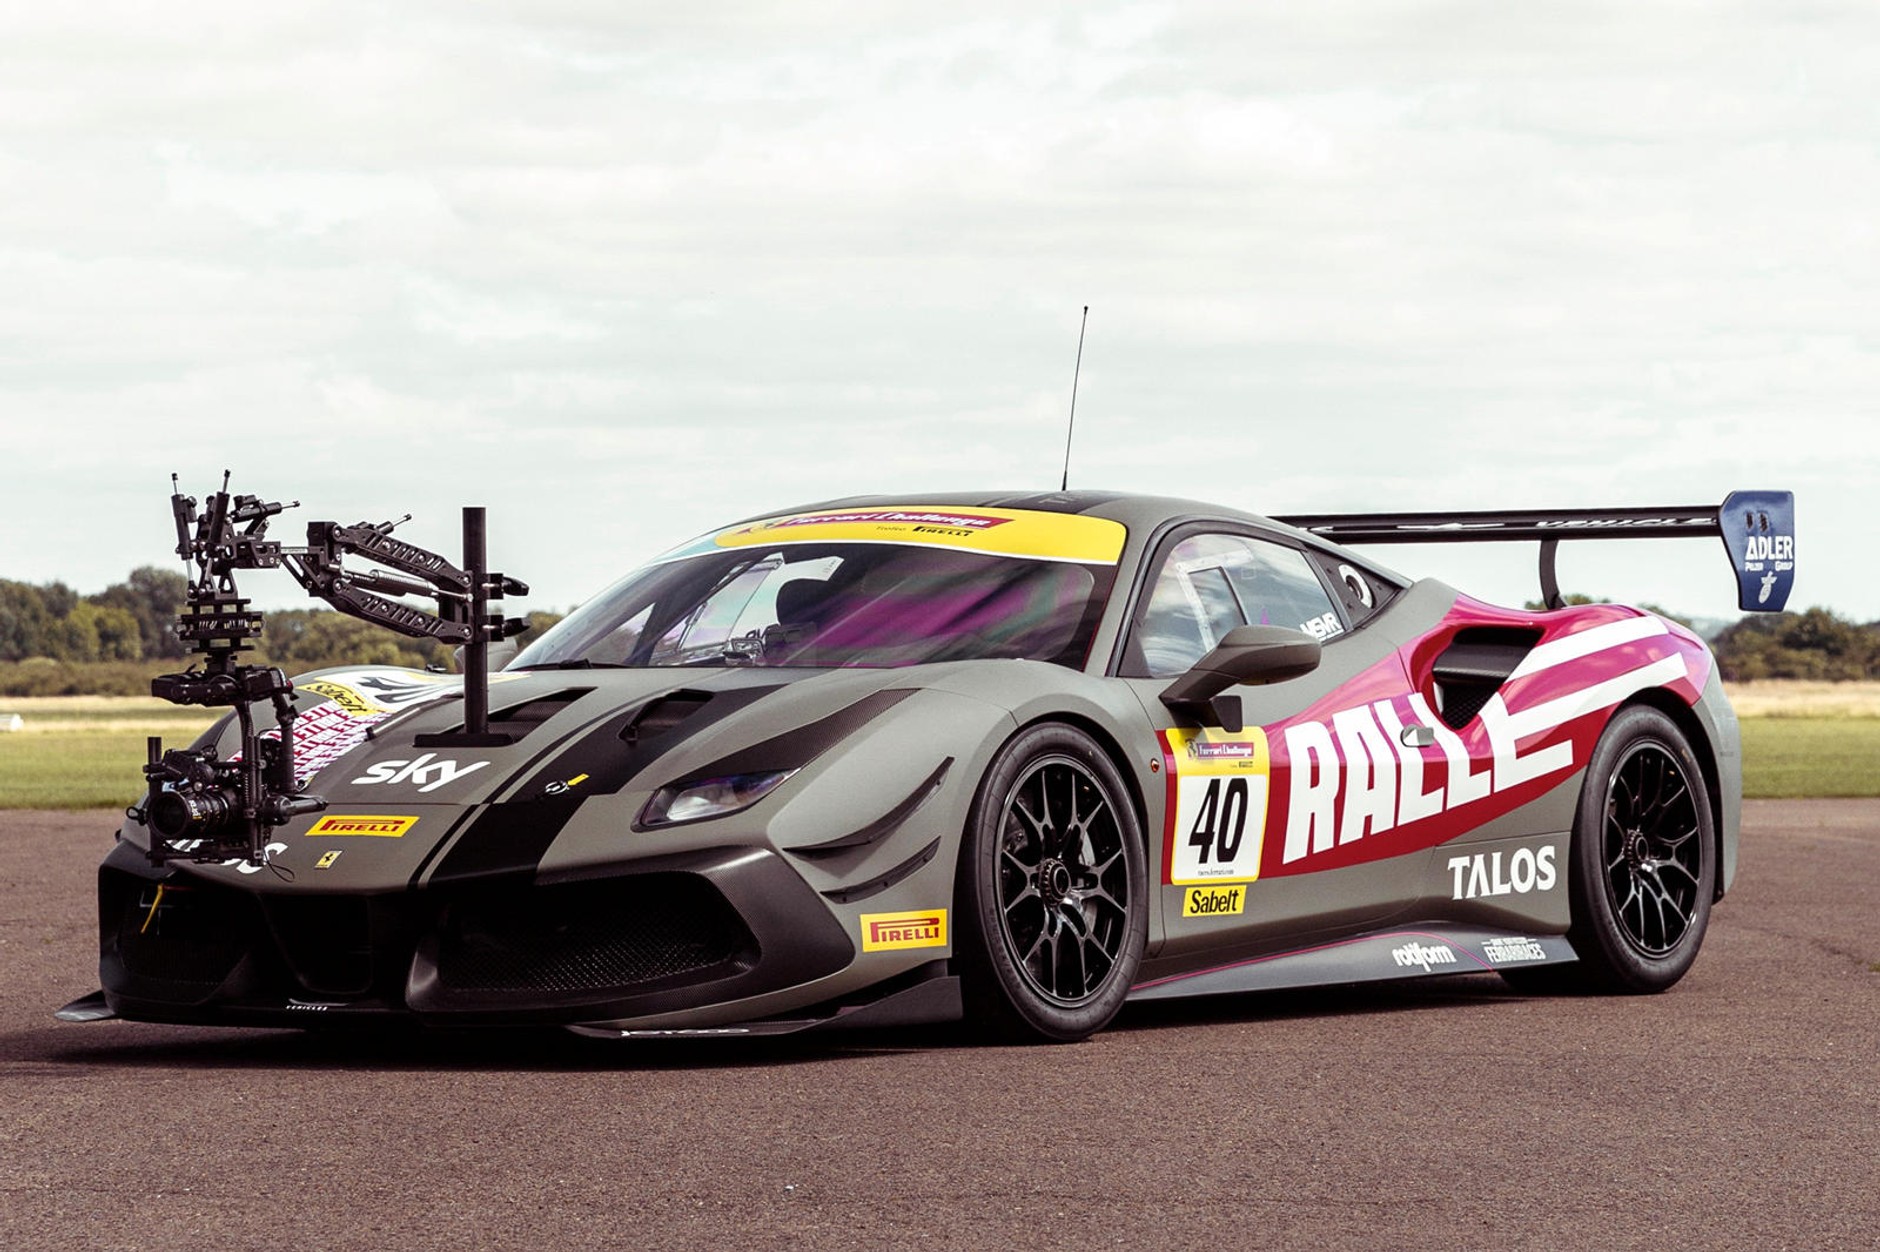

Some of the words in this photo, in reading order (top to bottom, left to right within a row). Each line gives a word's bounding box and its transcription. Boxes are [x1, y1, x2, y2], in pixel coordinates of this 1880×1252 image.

[913, 526, 974, 537] PIRELLI
[1745, 535, 1793, 560] ADLER
[351, 752, 491, 793] sky
[1282, 680, 1590, 865] RALLE
[320, 819, 406, 832] PIRELLI
[1188, 778, 1249, 864] 40
[1447, 845, 1557, 900] TALOS
[1190, 889, 1240, 914] Sabelt
[870, 916, 940, 943] PIRELLI
